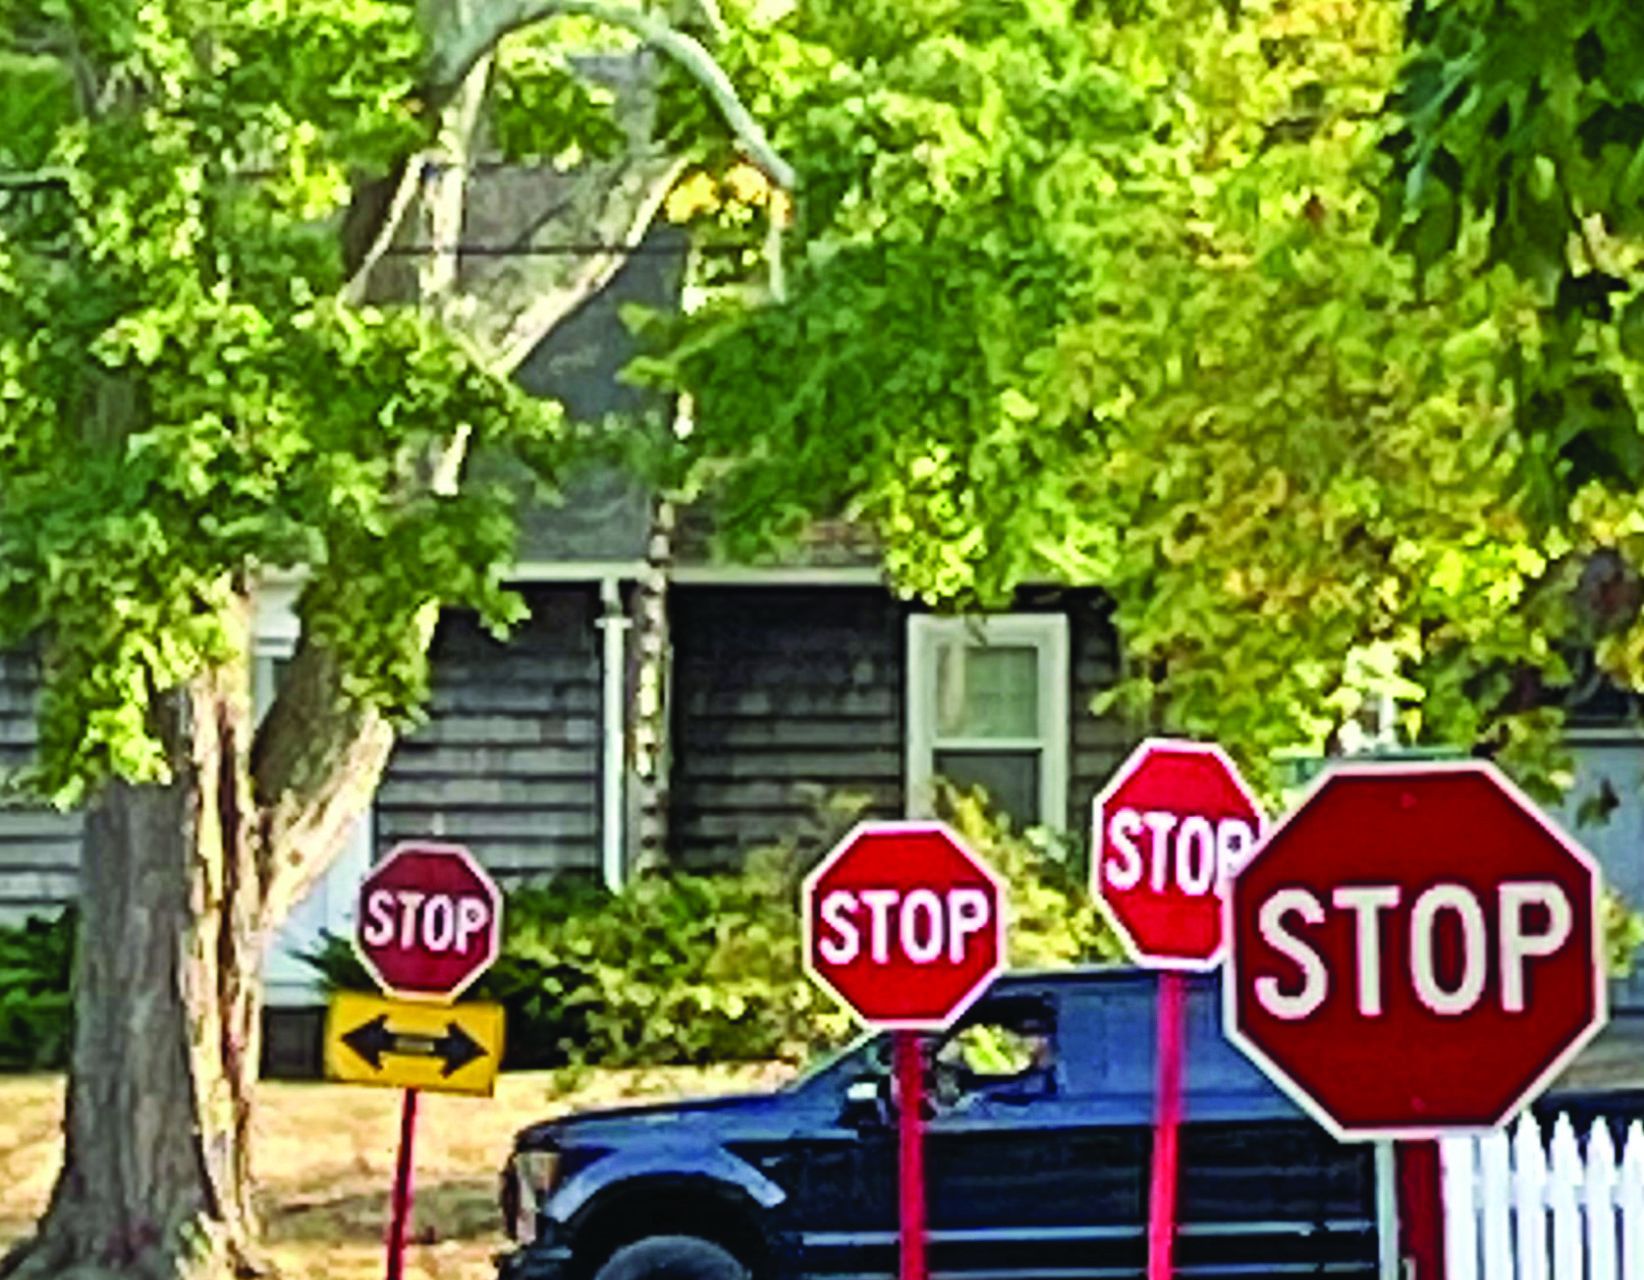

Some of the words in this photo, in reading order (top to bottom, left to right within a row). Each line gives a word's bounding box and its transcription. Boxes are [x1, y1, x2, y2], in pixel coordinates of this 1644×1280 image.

[1106, 808, 1254, 896] STOP
[365, 890, 489, 954] STOP
[818, 889, 989, 965] STOP
[1254, 881, 1573, 1020] STOP
